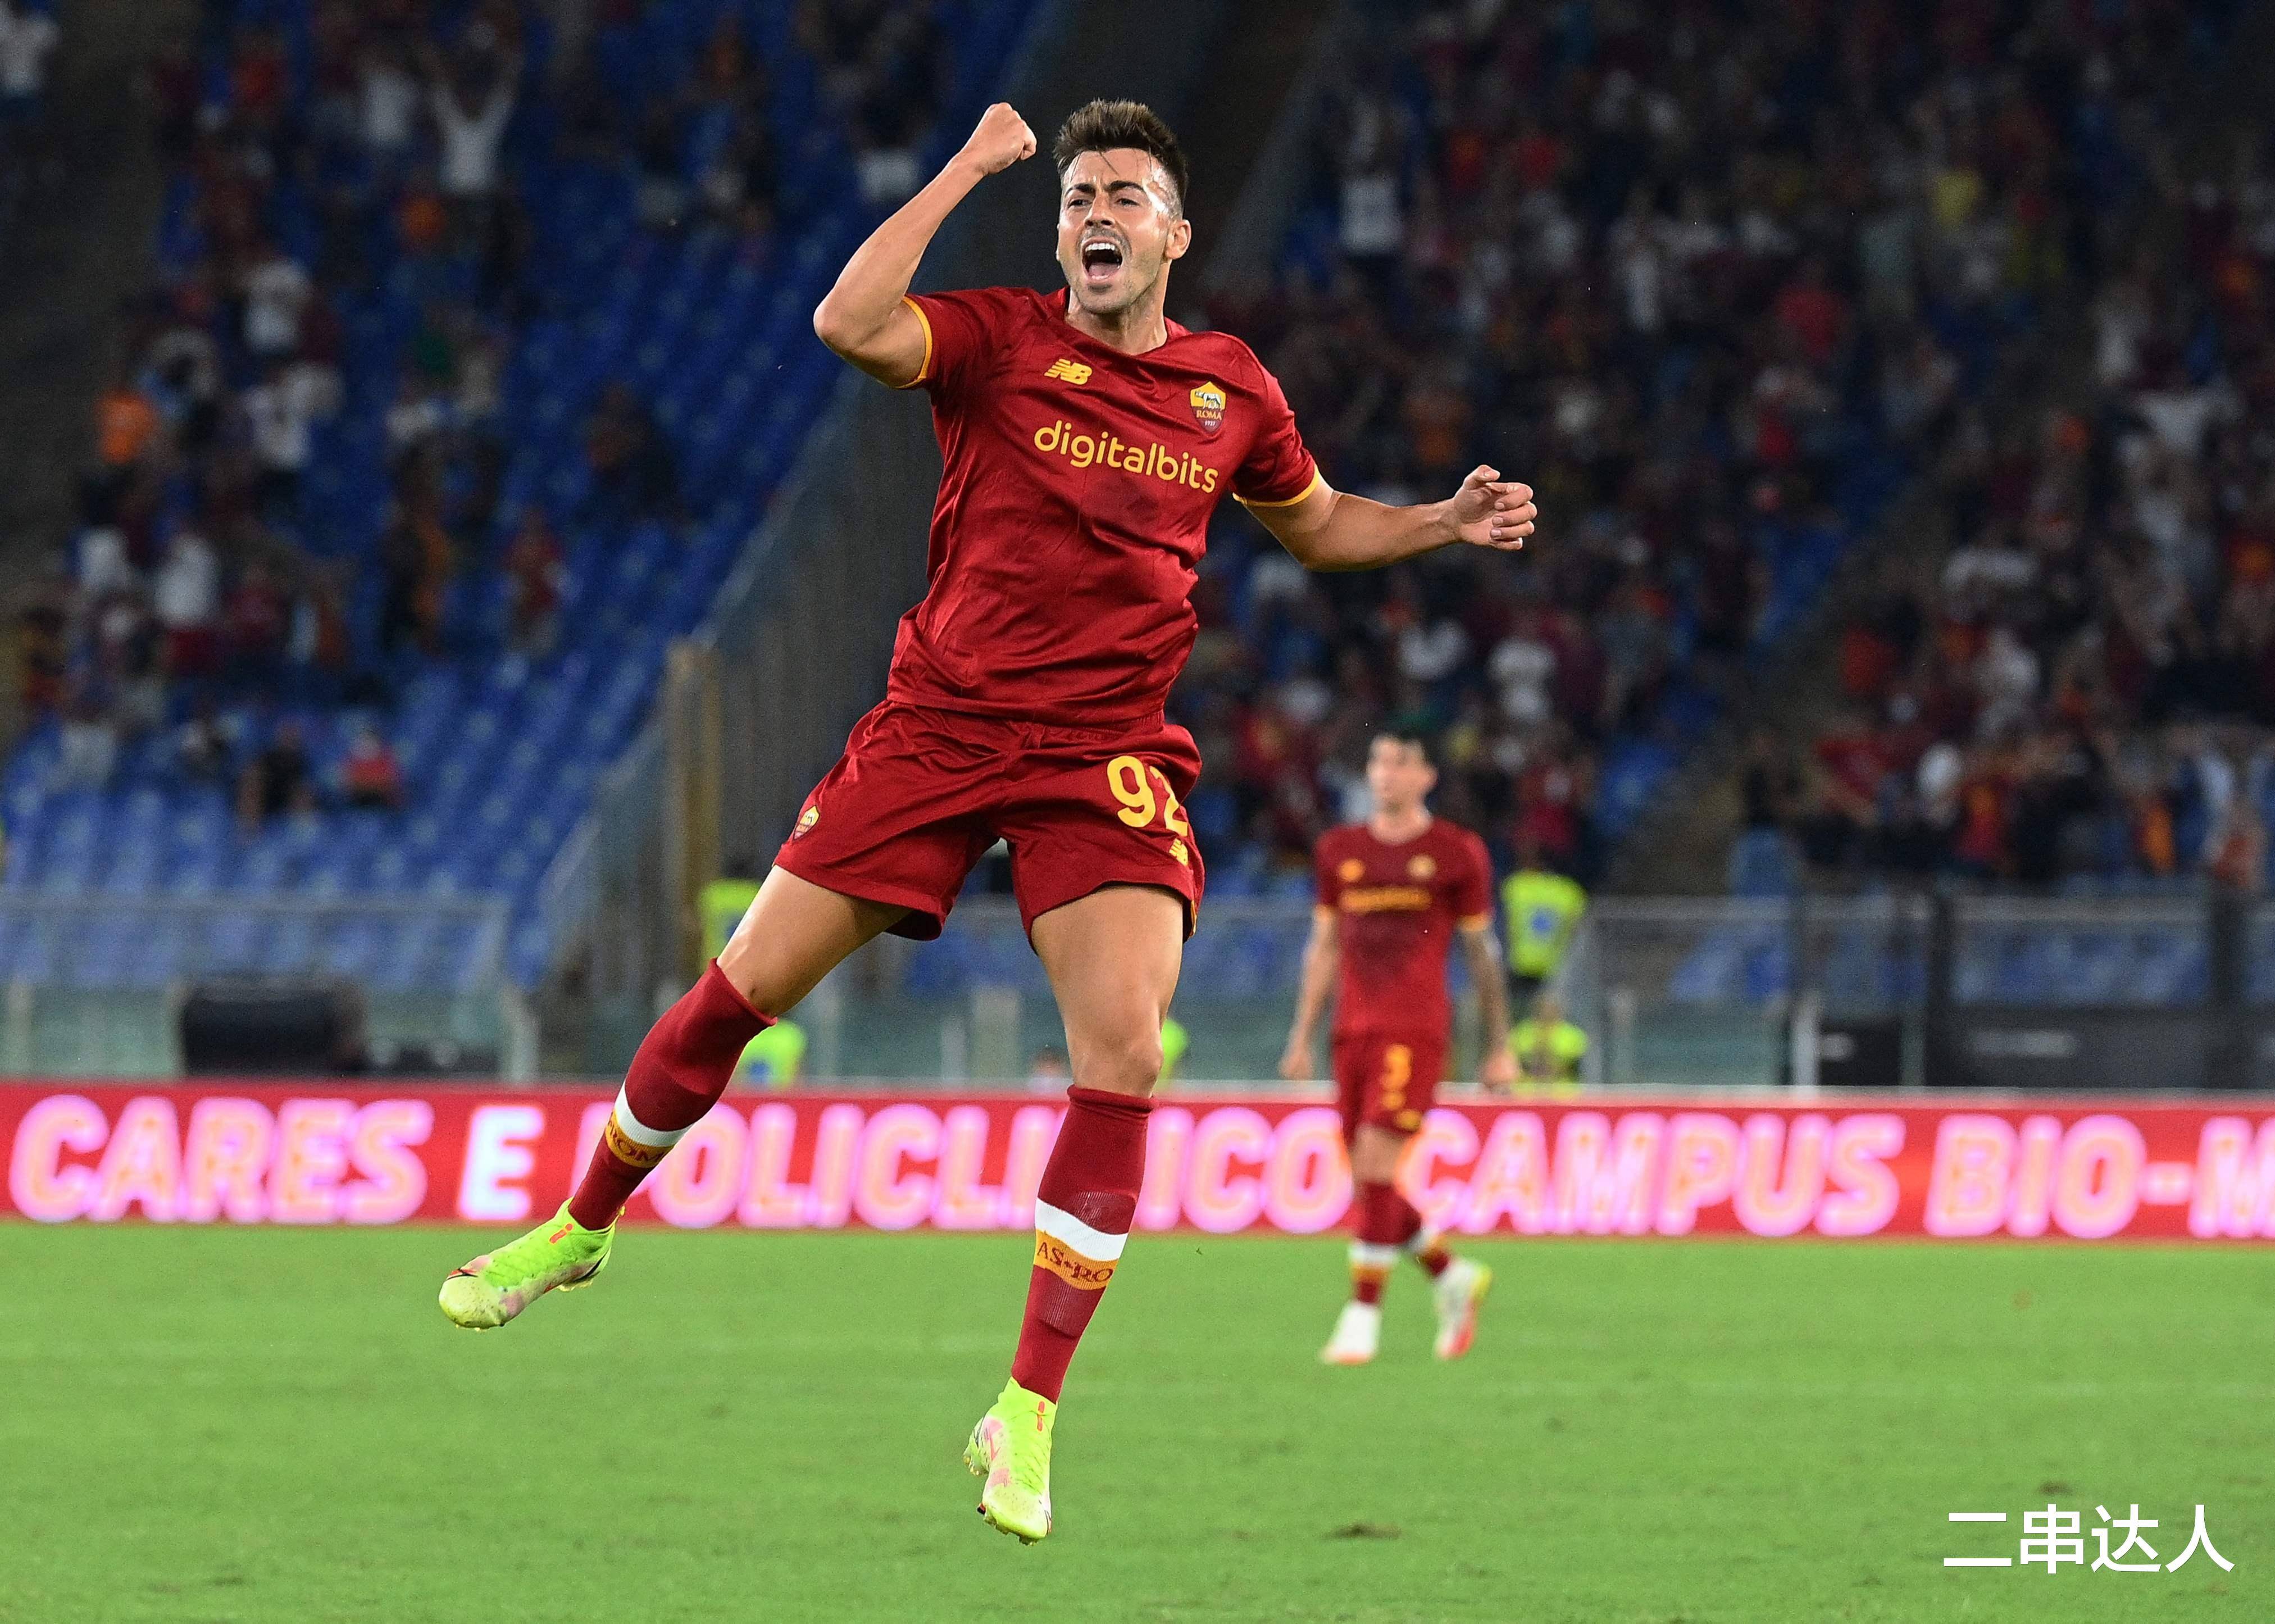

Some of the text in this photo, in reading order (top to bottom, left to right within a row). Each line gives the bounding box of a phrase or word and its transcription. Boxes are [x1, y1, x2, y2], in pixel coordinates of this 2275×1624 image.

[1196, 410, 1222, 420] ROMA
[1034, 420, 1218, 493] digitalbits
[1107, 755, 1188, 837] 92
[8, 1094, 434, 1225] CARES
[455, 1103, 545, 1222] E
[568, 1101, 1354, 1235] OLICLIICO
[1393, 1108, 1904, 1237] CAMPUS
